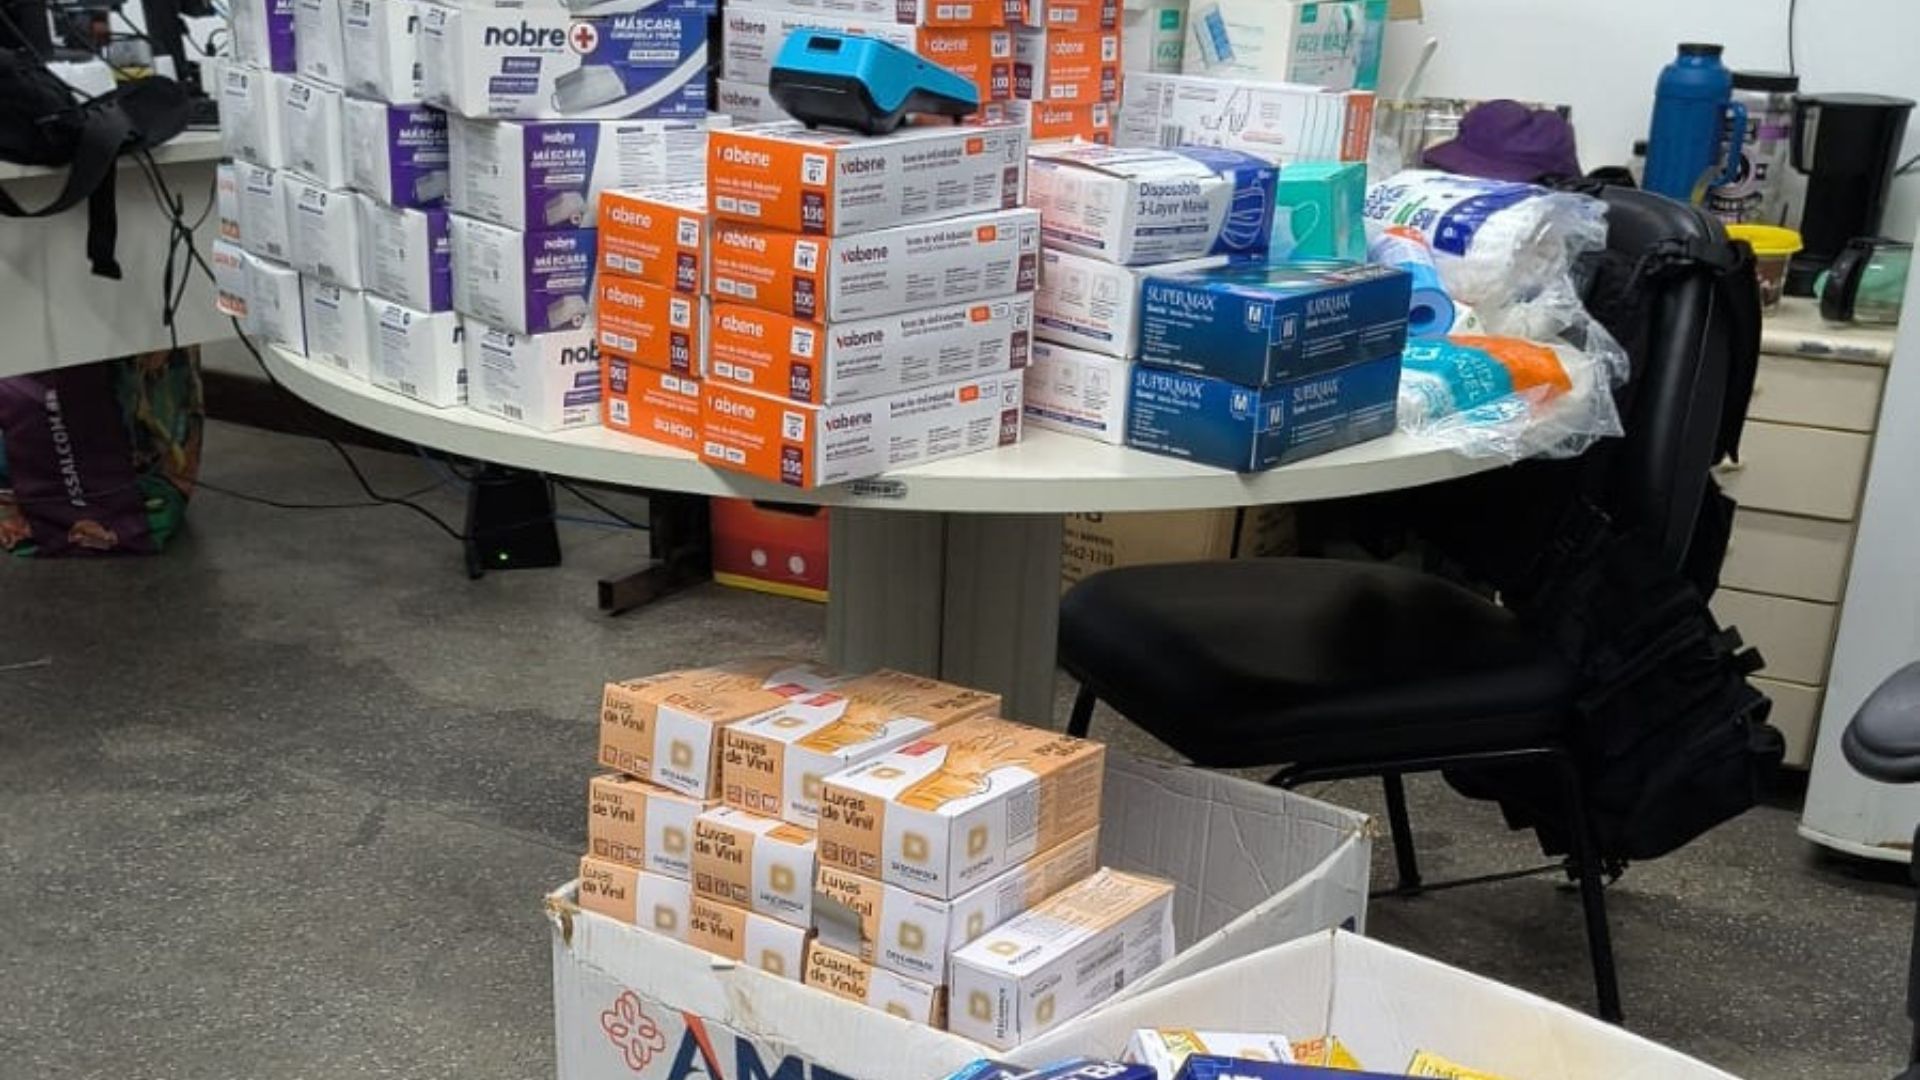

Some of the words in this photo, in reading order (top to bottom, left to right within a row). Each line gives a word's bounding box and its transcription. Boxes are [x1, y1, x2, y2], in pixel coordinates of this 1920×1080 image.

[485, 20, 566, 46] nobre
[613, 16, 681, 31] MÁSCARA
[841, 156, 886, 174] vabene
[1140, 182, 1201, 198] Disposable
[1137, 202, 1180, 217] 3-Layer
[840, 244, 888, 264] vabene
[1147, 285, 1217, 312] SUPERMAX
[836, 329, 885, 349] vabene
[1137, 372, 1206, 400] SUPERMAX
[825, 411, 872, 431] vabene
[604, 710, 618, 722] de
[621, 712, 645, 732] Vinil
[727, 733, 768, 757] Luvas
[726, 752, 742, 765] de
[750, 754, 775, 774] Vinil
[823, 787, 866, 811] Luvas
[593, 804, 608, 816] de
[610, 806, 636, 823] Vinil
[822, 805, 840, 821] de
[844, 810, 874, 831] Vinil
[695, 820, 736, 846] Luvas
[694, 839, 711, 853] de
[715, 843, 743, 864] Vinil
[582, 881, 597, 893] de
[600, 884, 625, 900] Vinil
[821, 870, 862, 896] Luvas
[691, 919, 707, 932] de
[710, 922, 734, 942] Vinil
[812, 951, 866, 982] Guantes
[810, 968, 828, 981] de
[830, 975, 867, 998] Vinilo
